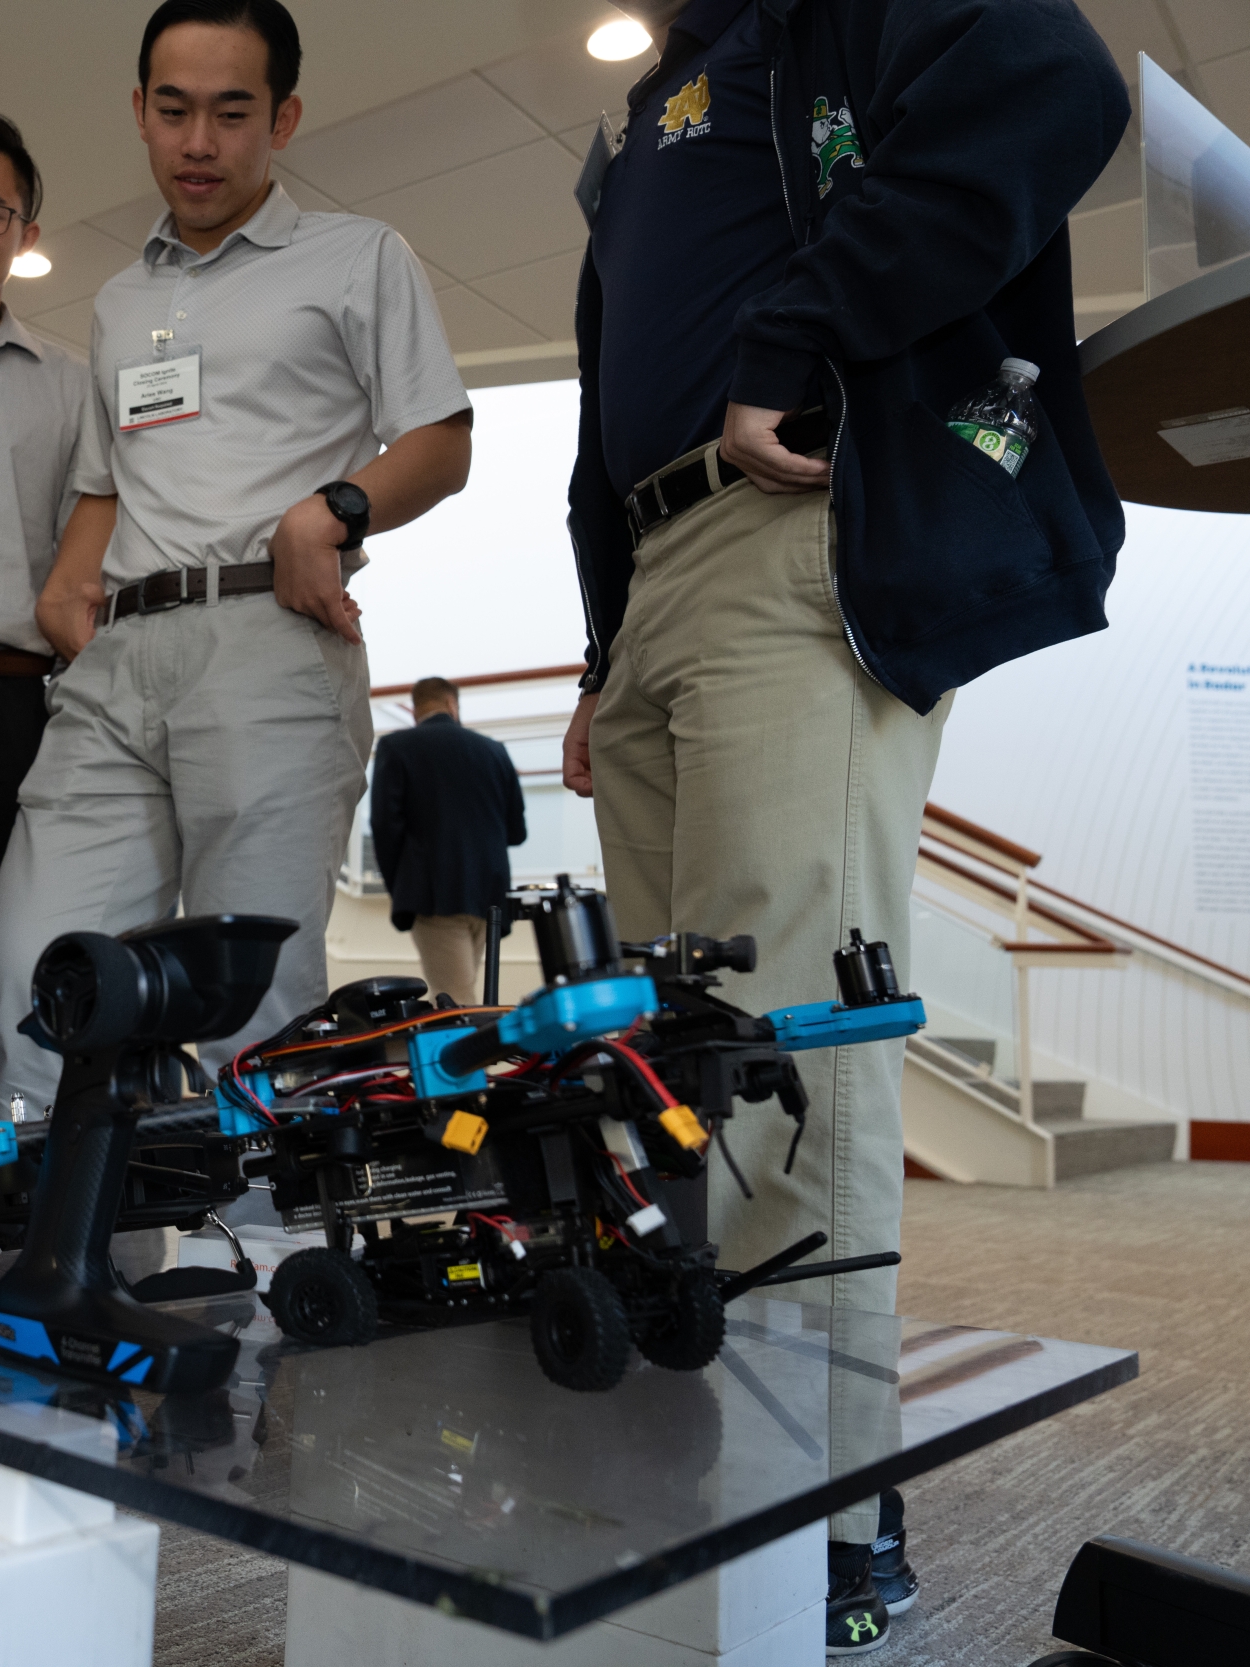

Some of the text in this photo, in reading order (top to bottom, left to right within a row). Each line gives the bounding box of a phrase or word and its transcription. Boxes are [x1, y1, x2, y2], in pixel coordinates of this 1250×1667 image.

[657, 122, 711, 150] ARMY ROTC
[870, 1539, 893, 1551] UNDER
[873, 1540, 900, 1555] ARMOUR
